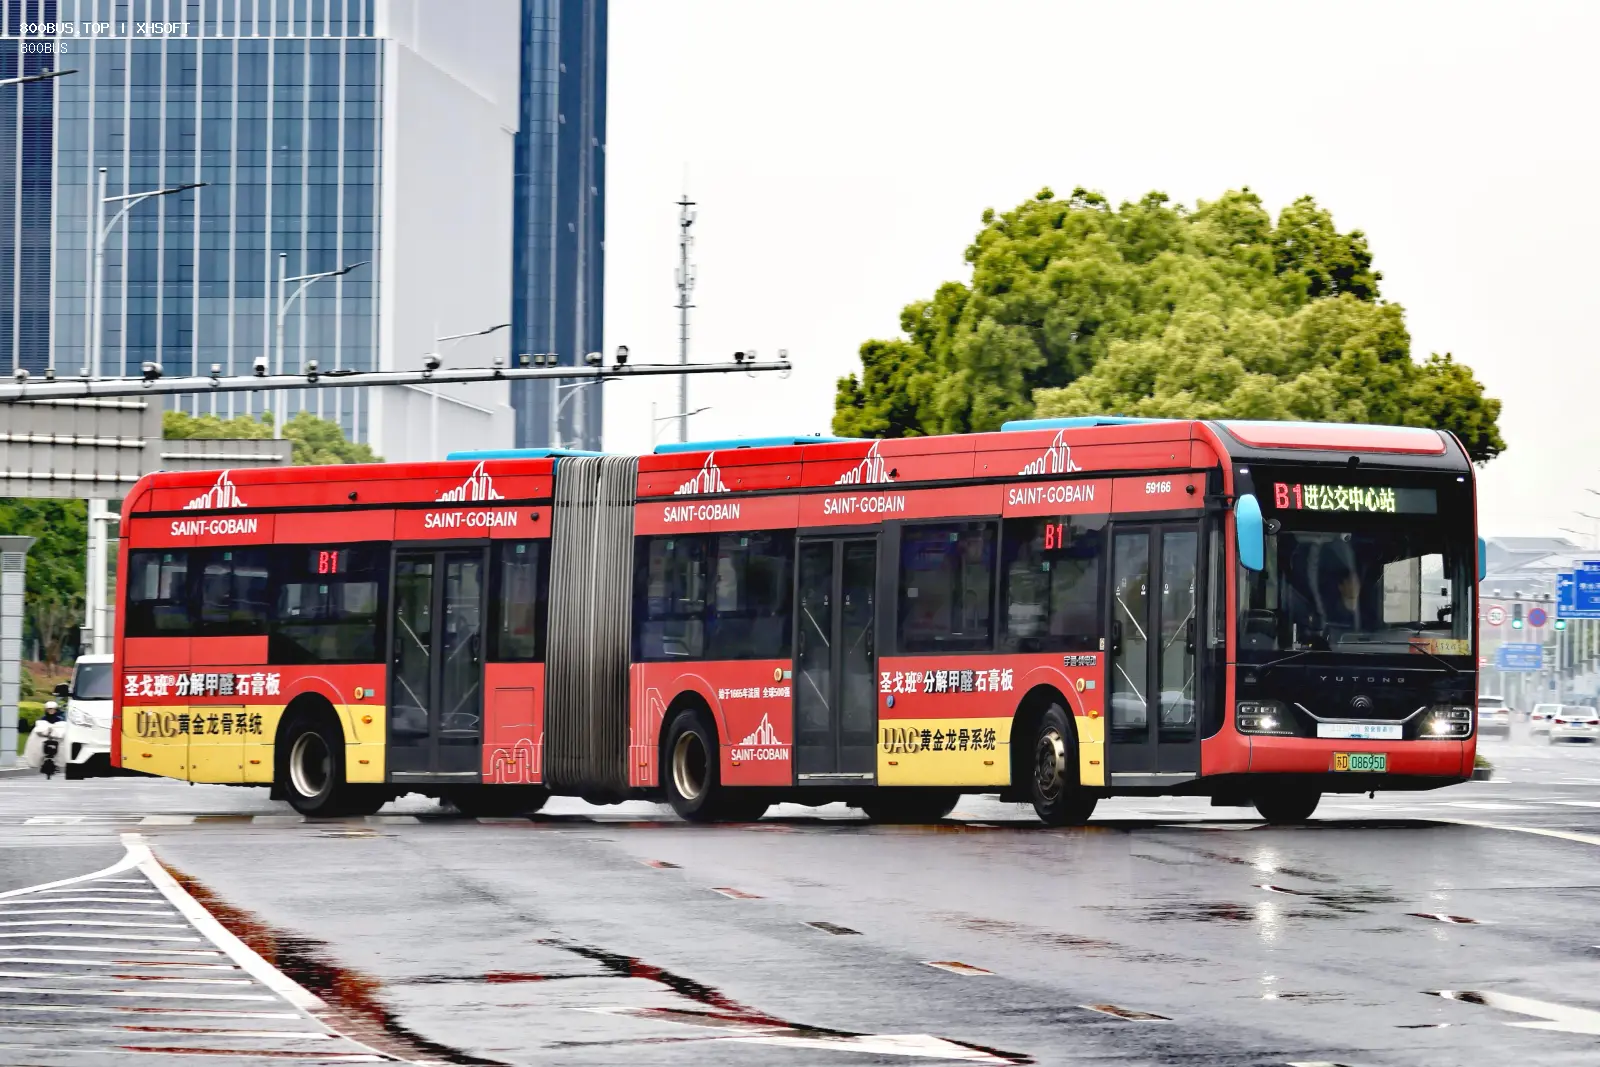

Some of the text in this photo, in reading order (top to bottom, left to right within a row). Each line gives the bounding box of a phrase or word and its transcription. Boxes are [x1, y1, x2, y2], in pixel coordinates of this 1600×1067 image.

[1008, 484, 1096, 506] SAINT-GOBAIN
[1145, 481, 1171, 495] 59166
[1274, 482, 1396, 513] B1 进公交中心站
[663, 503, 741, 523] SAINT-GOBAIN
[823, 495, 906, 515] SAINT-GOBAIN
[170, 518, 258, 536] SAINT-GOBAIN
[424, 511, 518, 529] SAINT-GOBAIN
[1045, 523, 1063, 550] B1
[318, 550, 338, 574] B1
[1320, 675, 1406, 683] YUTONG
[731, 748, 789, 761] SAINT-GOBAIN
